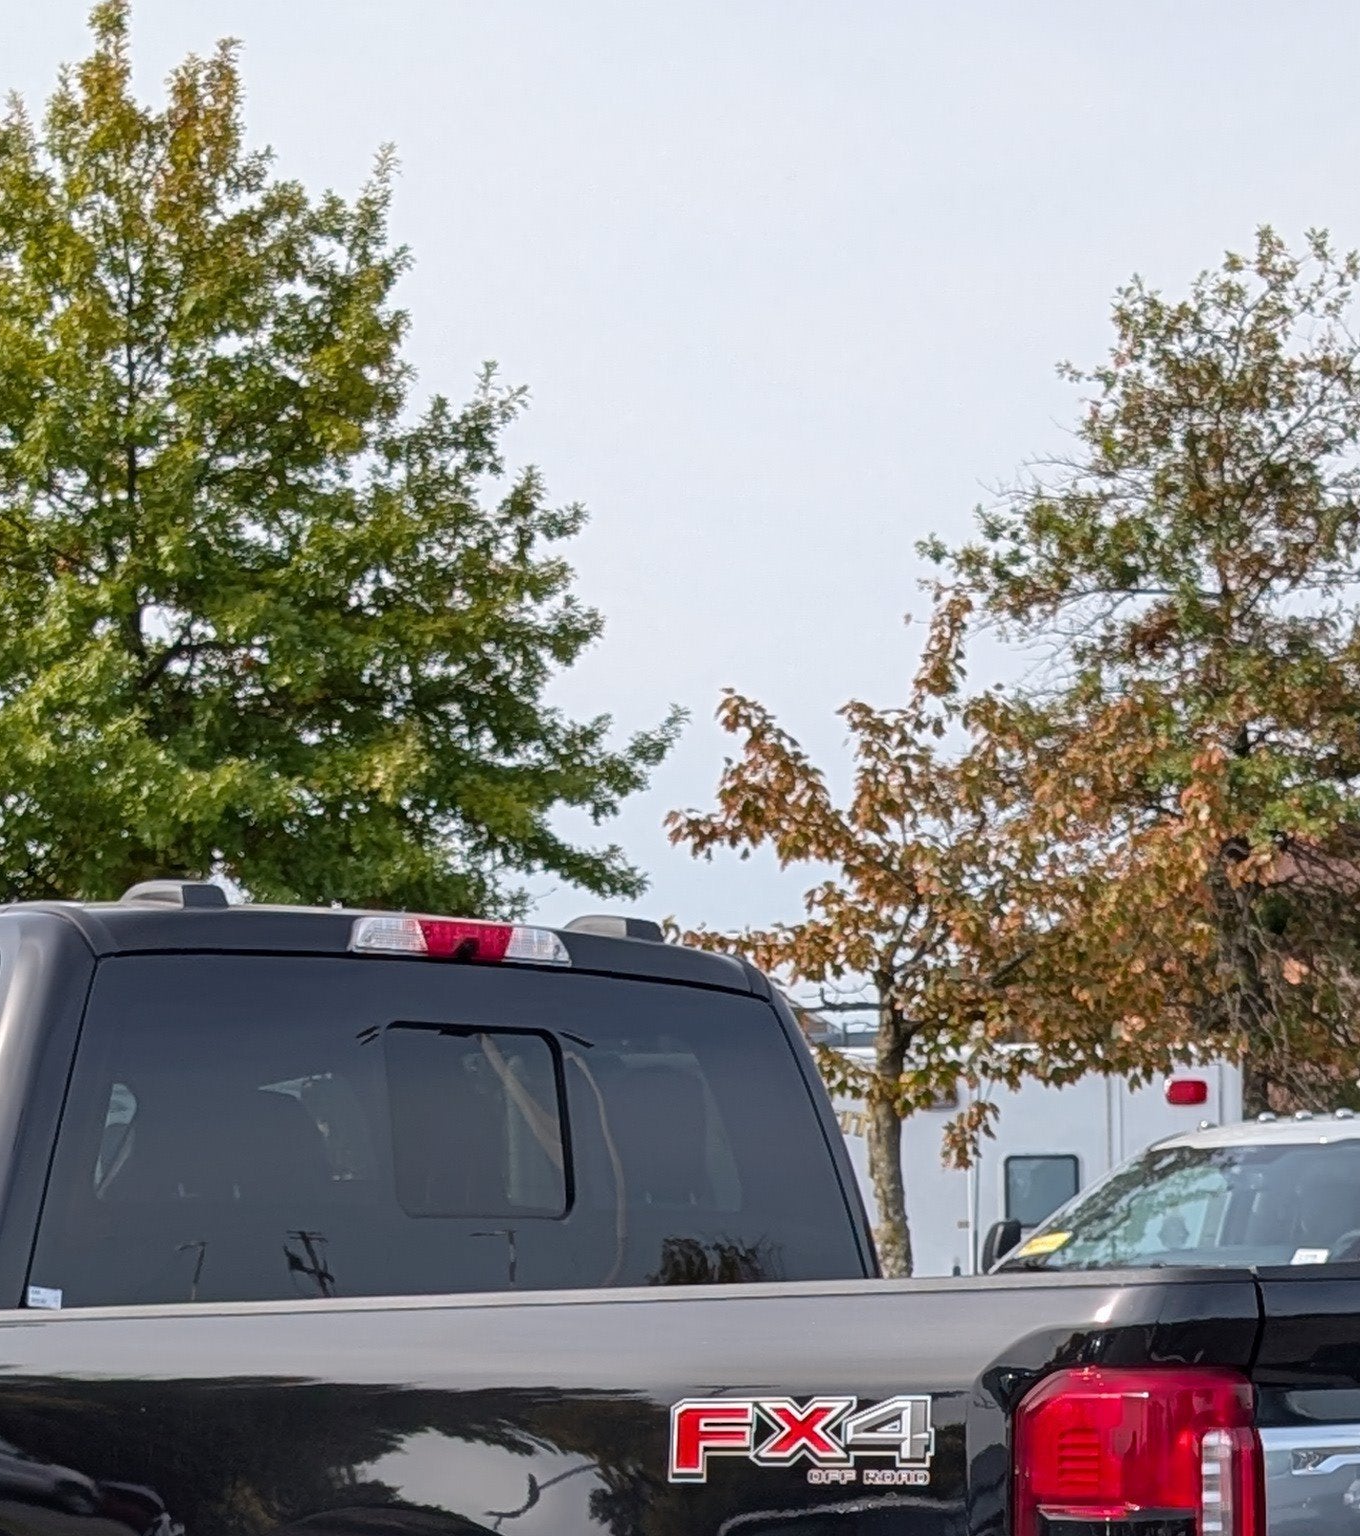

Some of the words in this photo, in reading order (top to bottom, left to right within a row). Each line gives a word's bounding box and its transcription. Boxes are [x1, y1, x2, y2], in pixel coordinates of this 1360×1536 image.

[668, 1396, 935, 1483] FX4
[807, 1469, 856, 1484] OFF
[863, 1469, 930, 1486] ROAD
